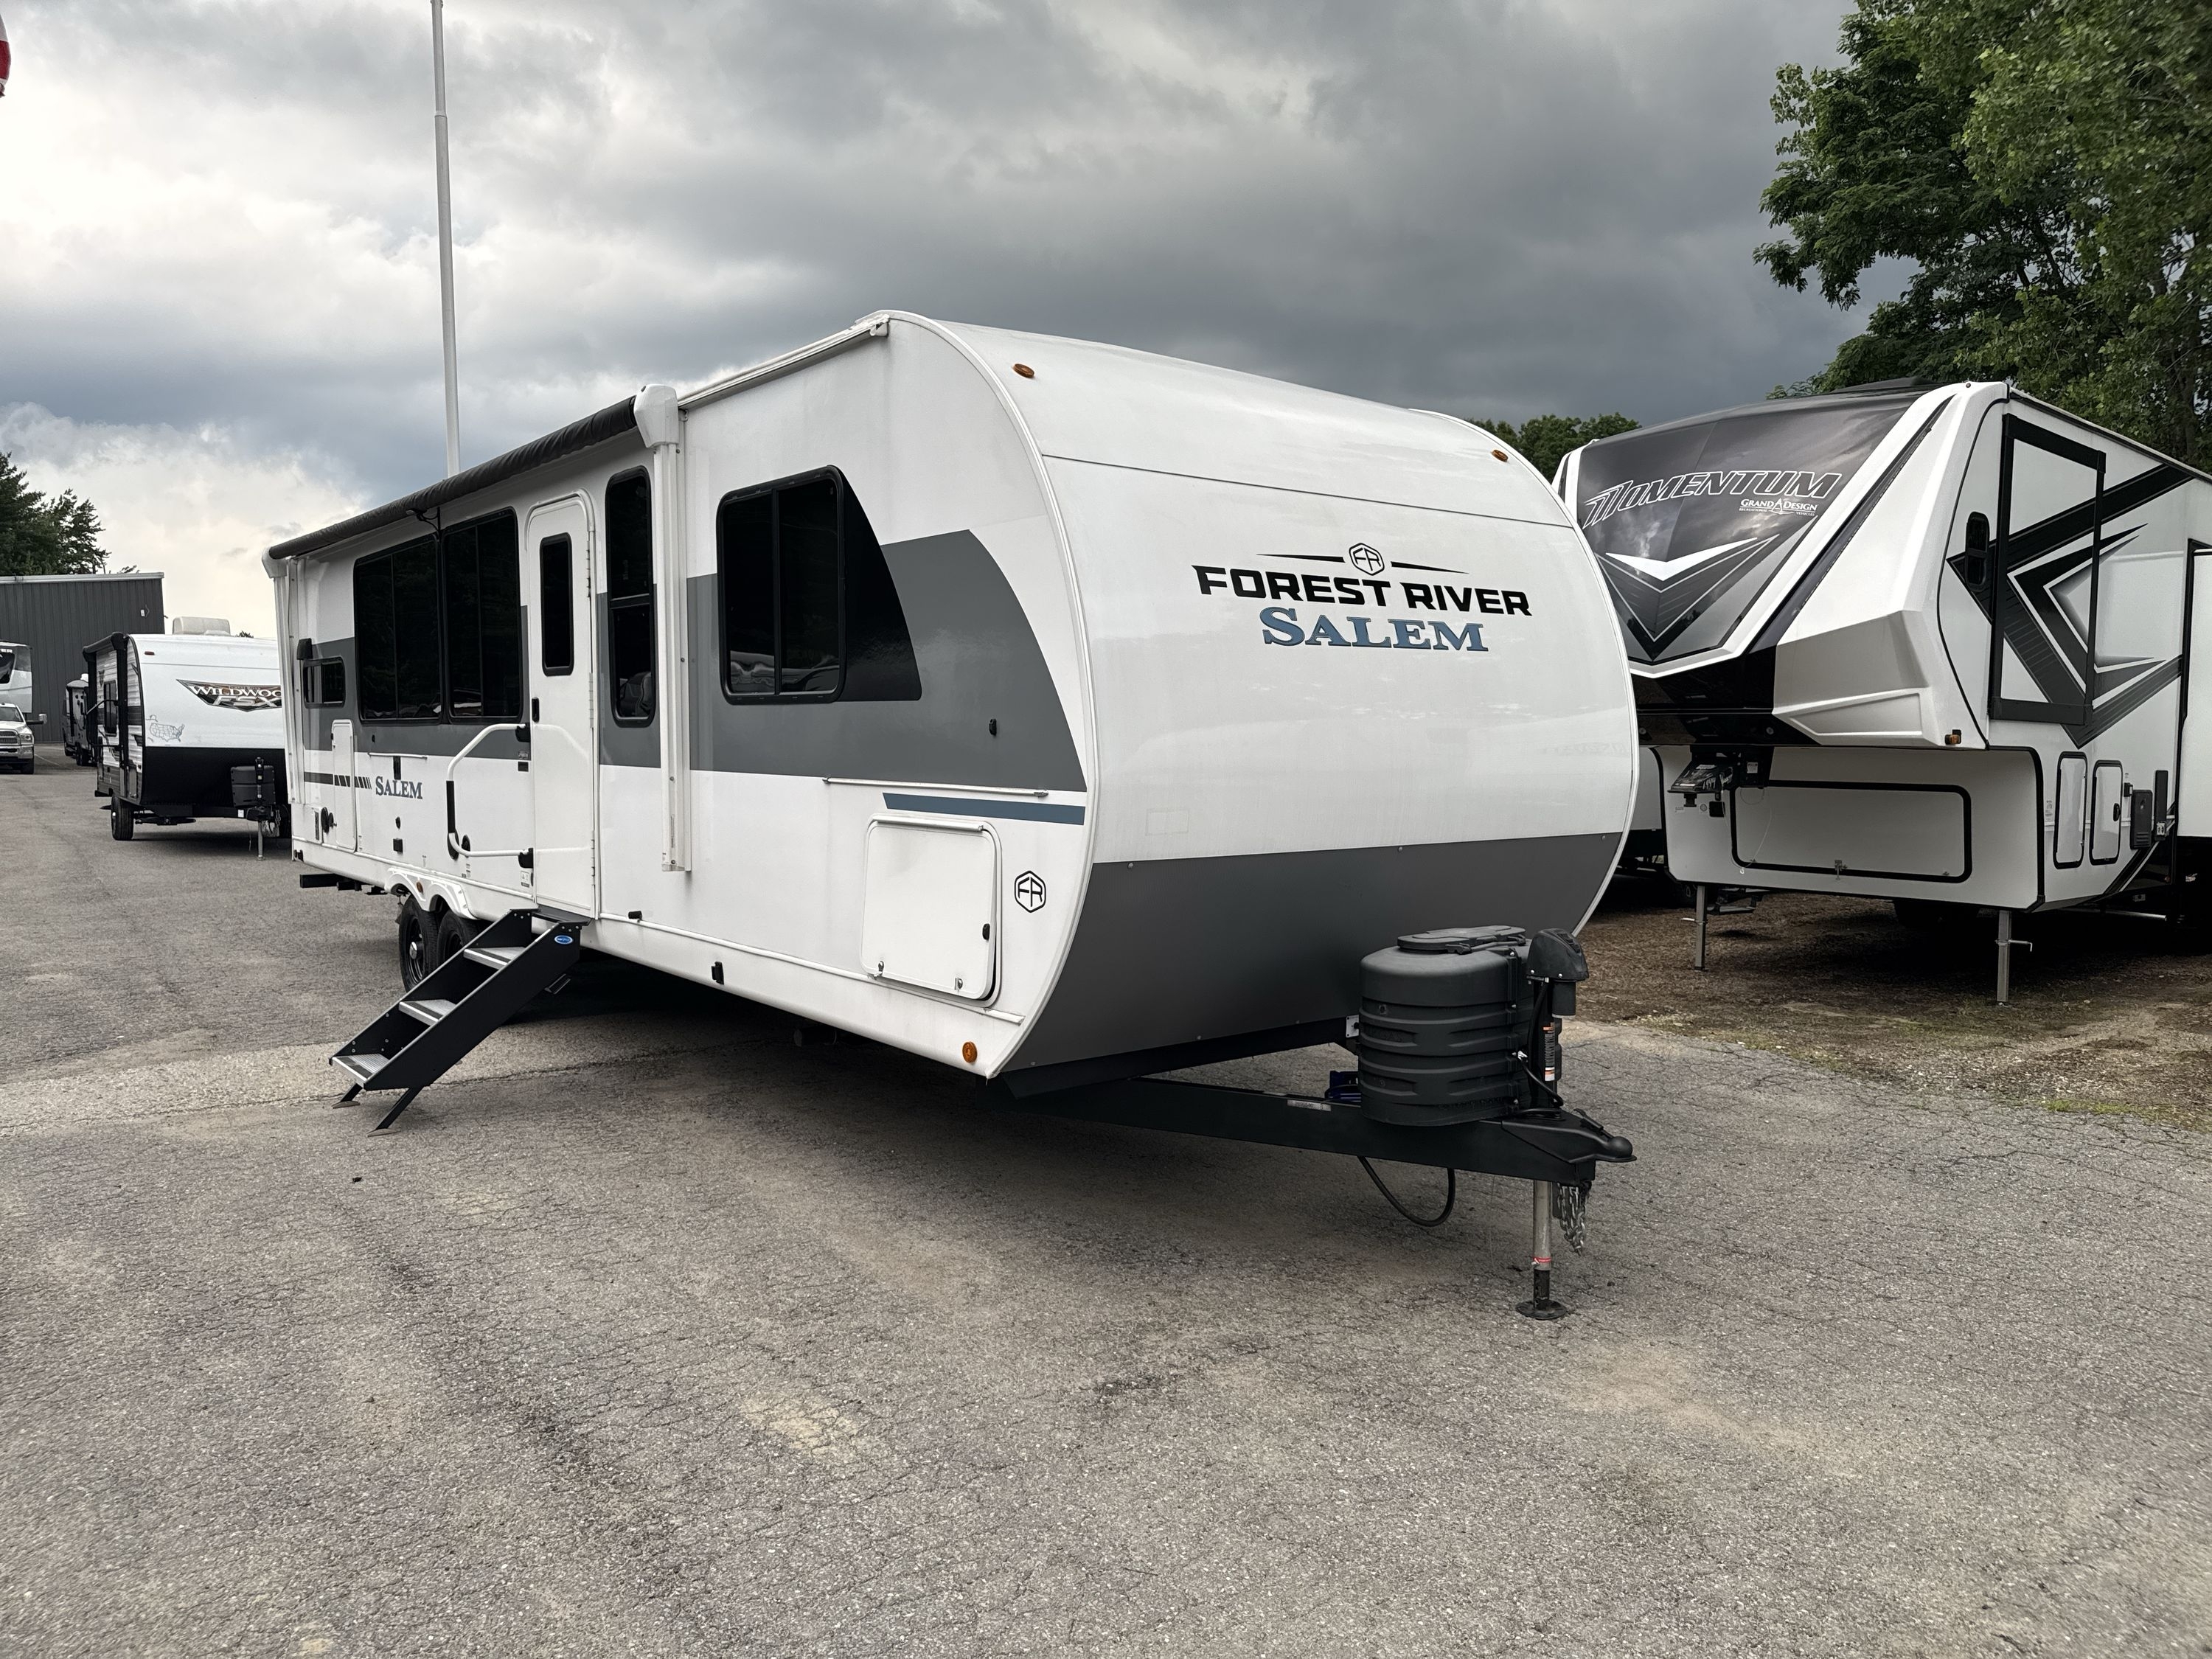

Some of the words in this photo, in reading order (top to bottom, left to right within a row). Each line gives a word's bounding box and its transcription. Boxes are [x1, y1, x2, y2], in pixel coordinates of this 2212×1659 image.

[1582, 470, 1843, 529] MOMENTUM
[1740, 498, 1775, 507] GRAND
[1783, 501, 1818, 511] DESIGN
[1192, 565, 1391, 607] FOREST
[1399, 582, 1533, 616] RIVER
[1259, 607, 1489, 652] SALEM
[375, 776, 423, 799] SALEM
